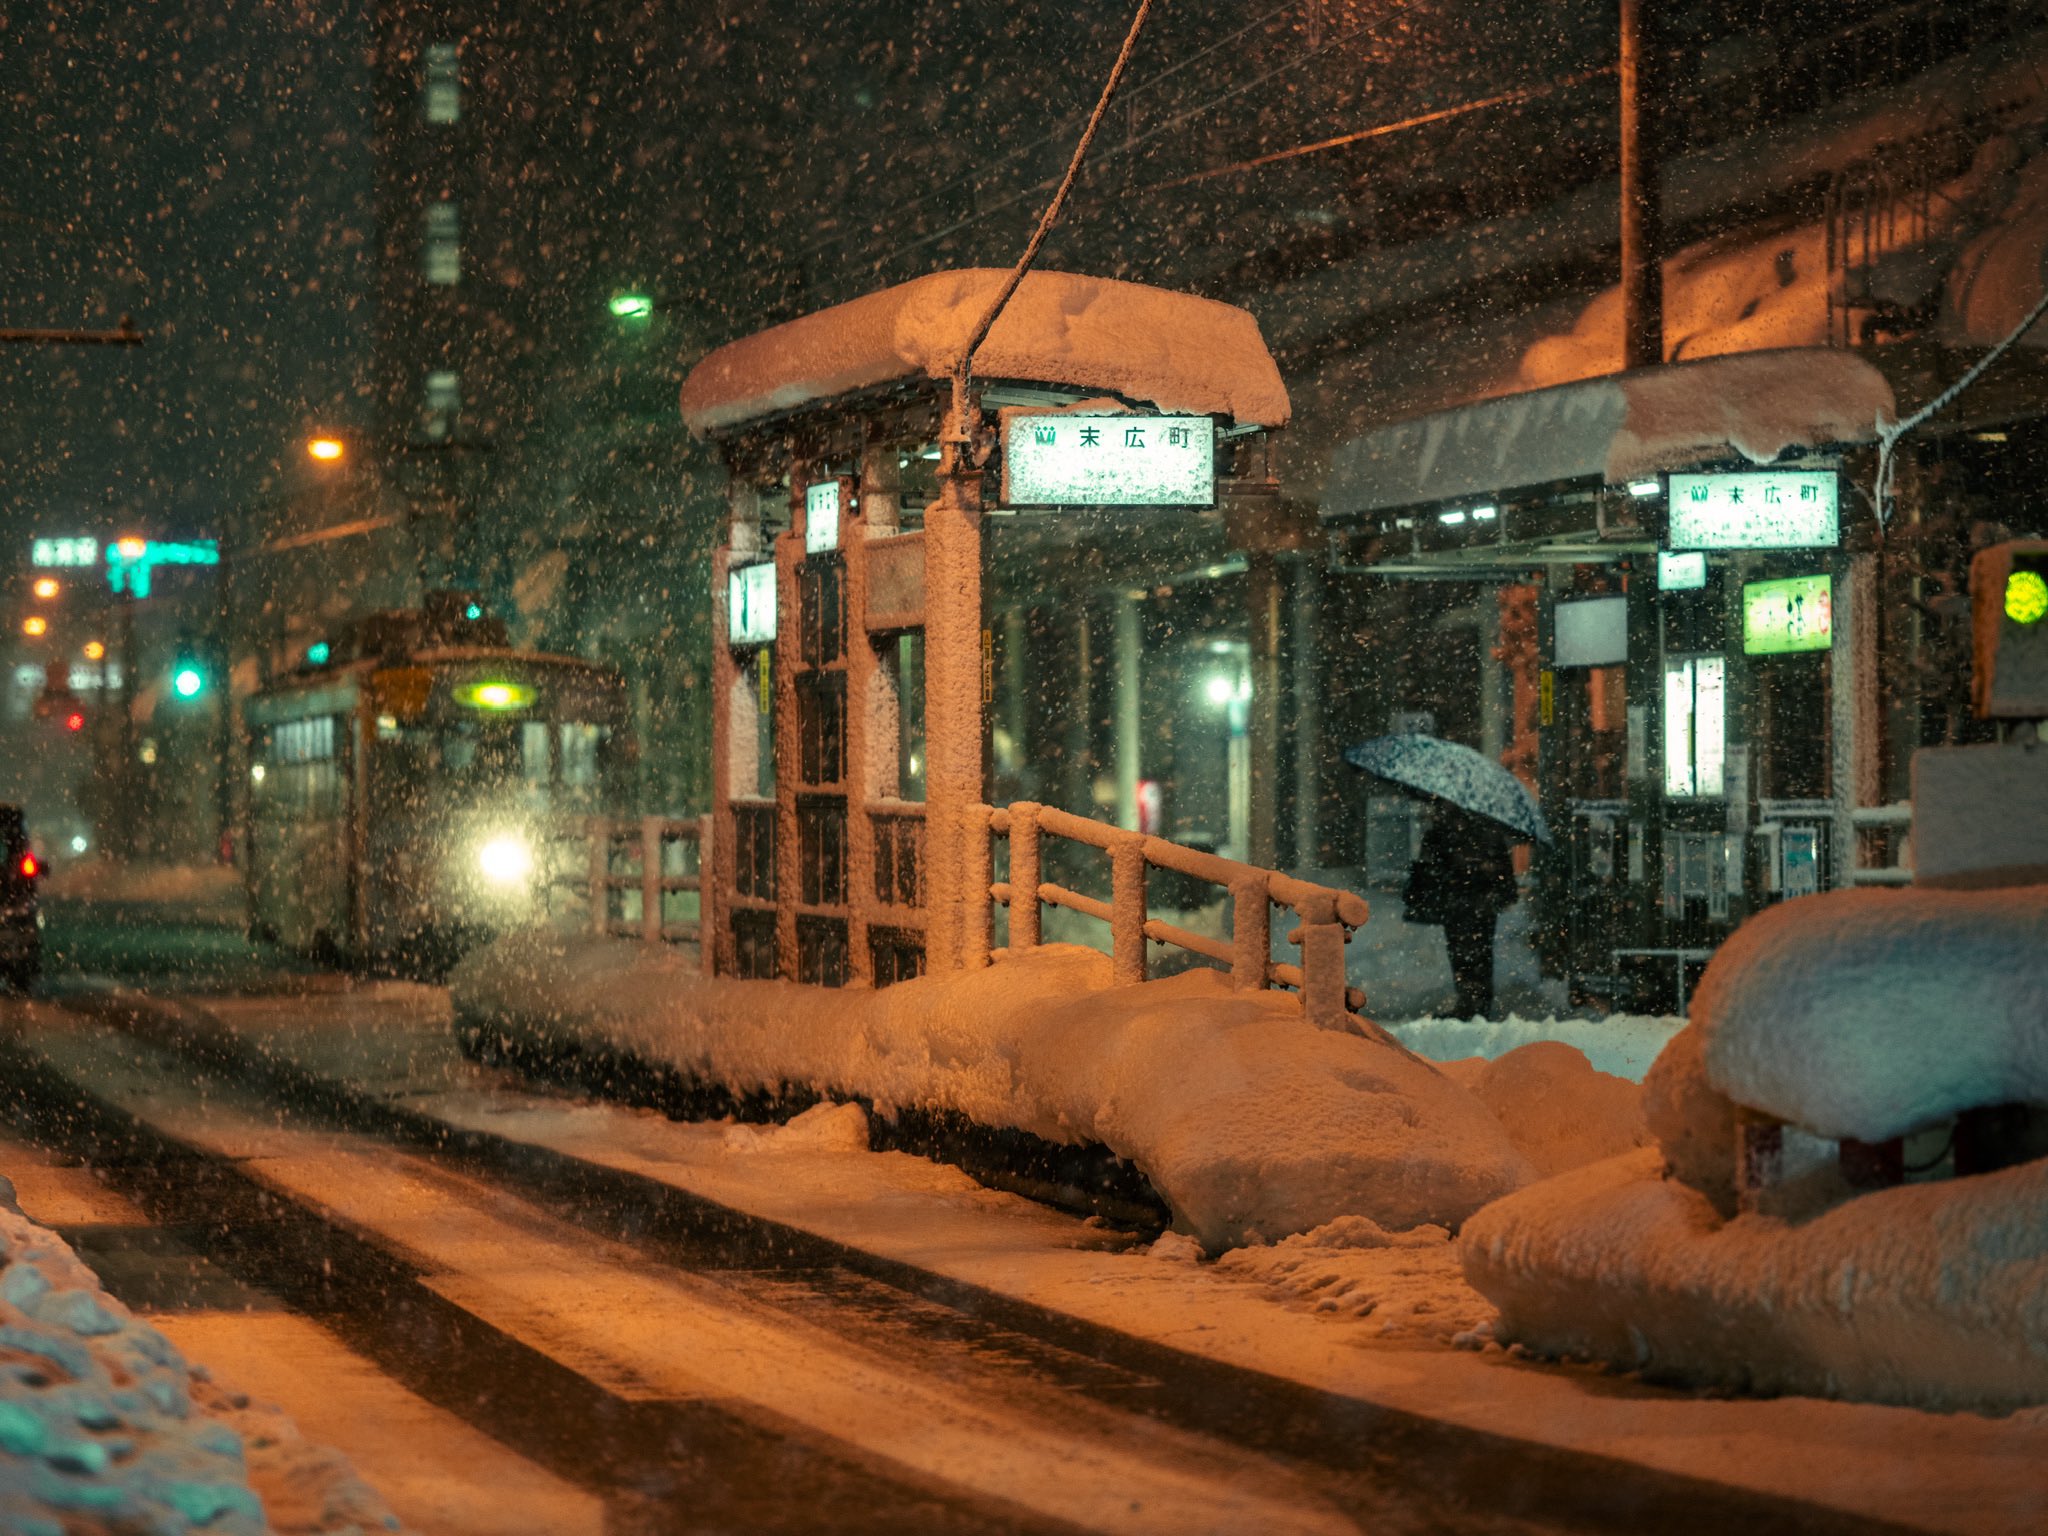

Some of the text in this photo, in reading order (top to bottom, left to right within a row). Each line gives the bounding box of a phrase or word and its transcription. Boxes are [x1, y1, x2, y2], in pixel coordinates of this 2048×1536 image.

[1079, 426, 1190, 449] 末広町
[1727, 485, 1819, 504] 末広町
